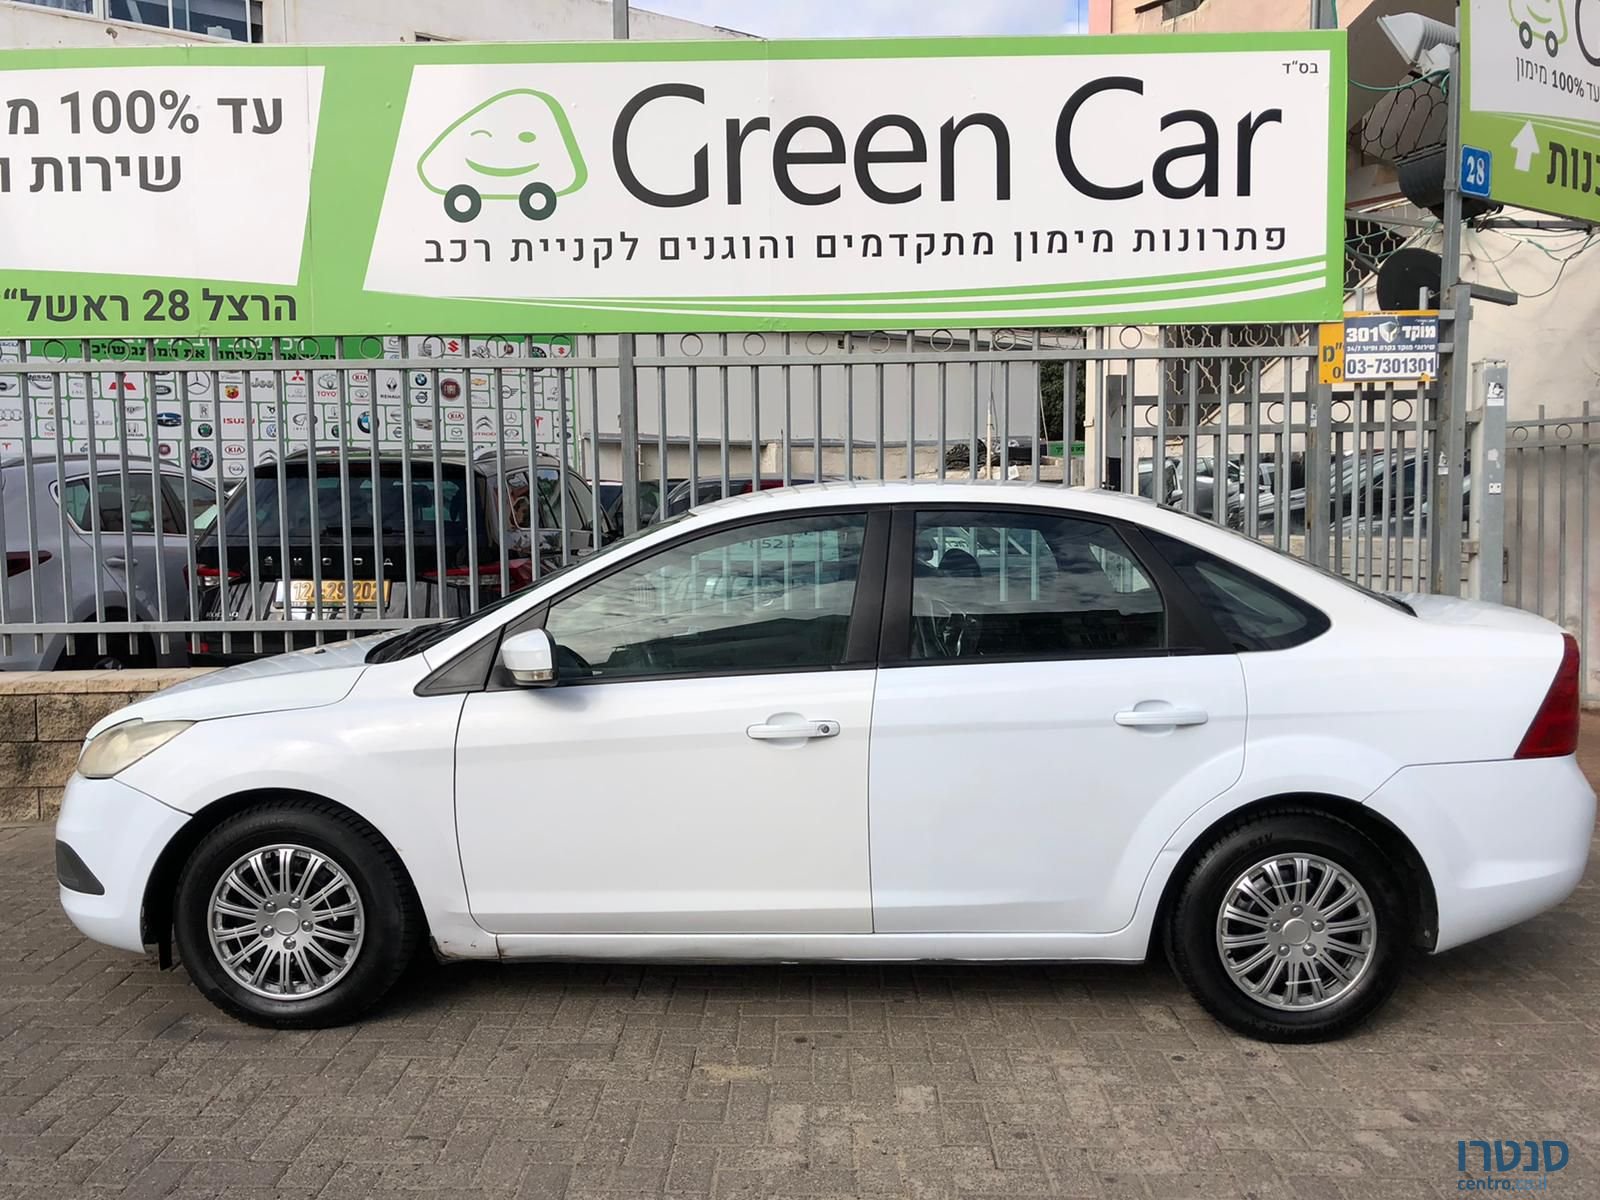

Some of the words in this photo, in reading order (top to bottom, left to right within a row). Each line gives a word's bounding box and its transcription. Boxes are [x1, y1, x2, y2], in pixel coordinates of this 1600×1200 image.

[1515, 56, 1547, 84] מימון
[1552, 69, 1584, 98] 100%
[7, 99, 39, 135] מ
[61, 90, 199, 135] 100%
[218, 98, 283, 135] עד
[613, 83, 1010, 207] Green
[1056, 77, 1283, 200] Car
[30, 157, 181, 193] שירות
[1467, 155, 1485, 185] 28
[425, 238, 491, 263] רכב
[511, 232, 639, 269] לקניית
[660, 235, 794, 261] והוגנים
[817, 231, 994, 265] מתקדמים
[1014, 230, 1112, 262] מימון
[1132, 227, 1285, 253] פתרונות
[143, 290, 189, 321] 28
[203, 288, 296, 321] הרצל
[1346, 327, 1378, 342] 301
[1402, 323, 1436, 341] מוקד
[1347, 357, 1435, 375] 03-7301301
[317, 390, 337, 398] TOYO
